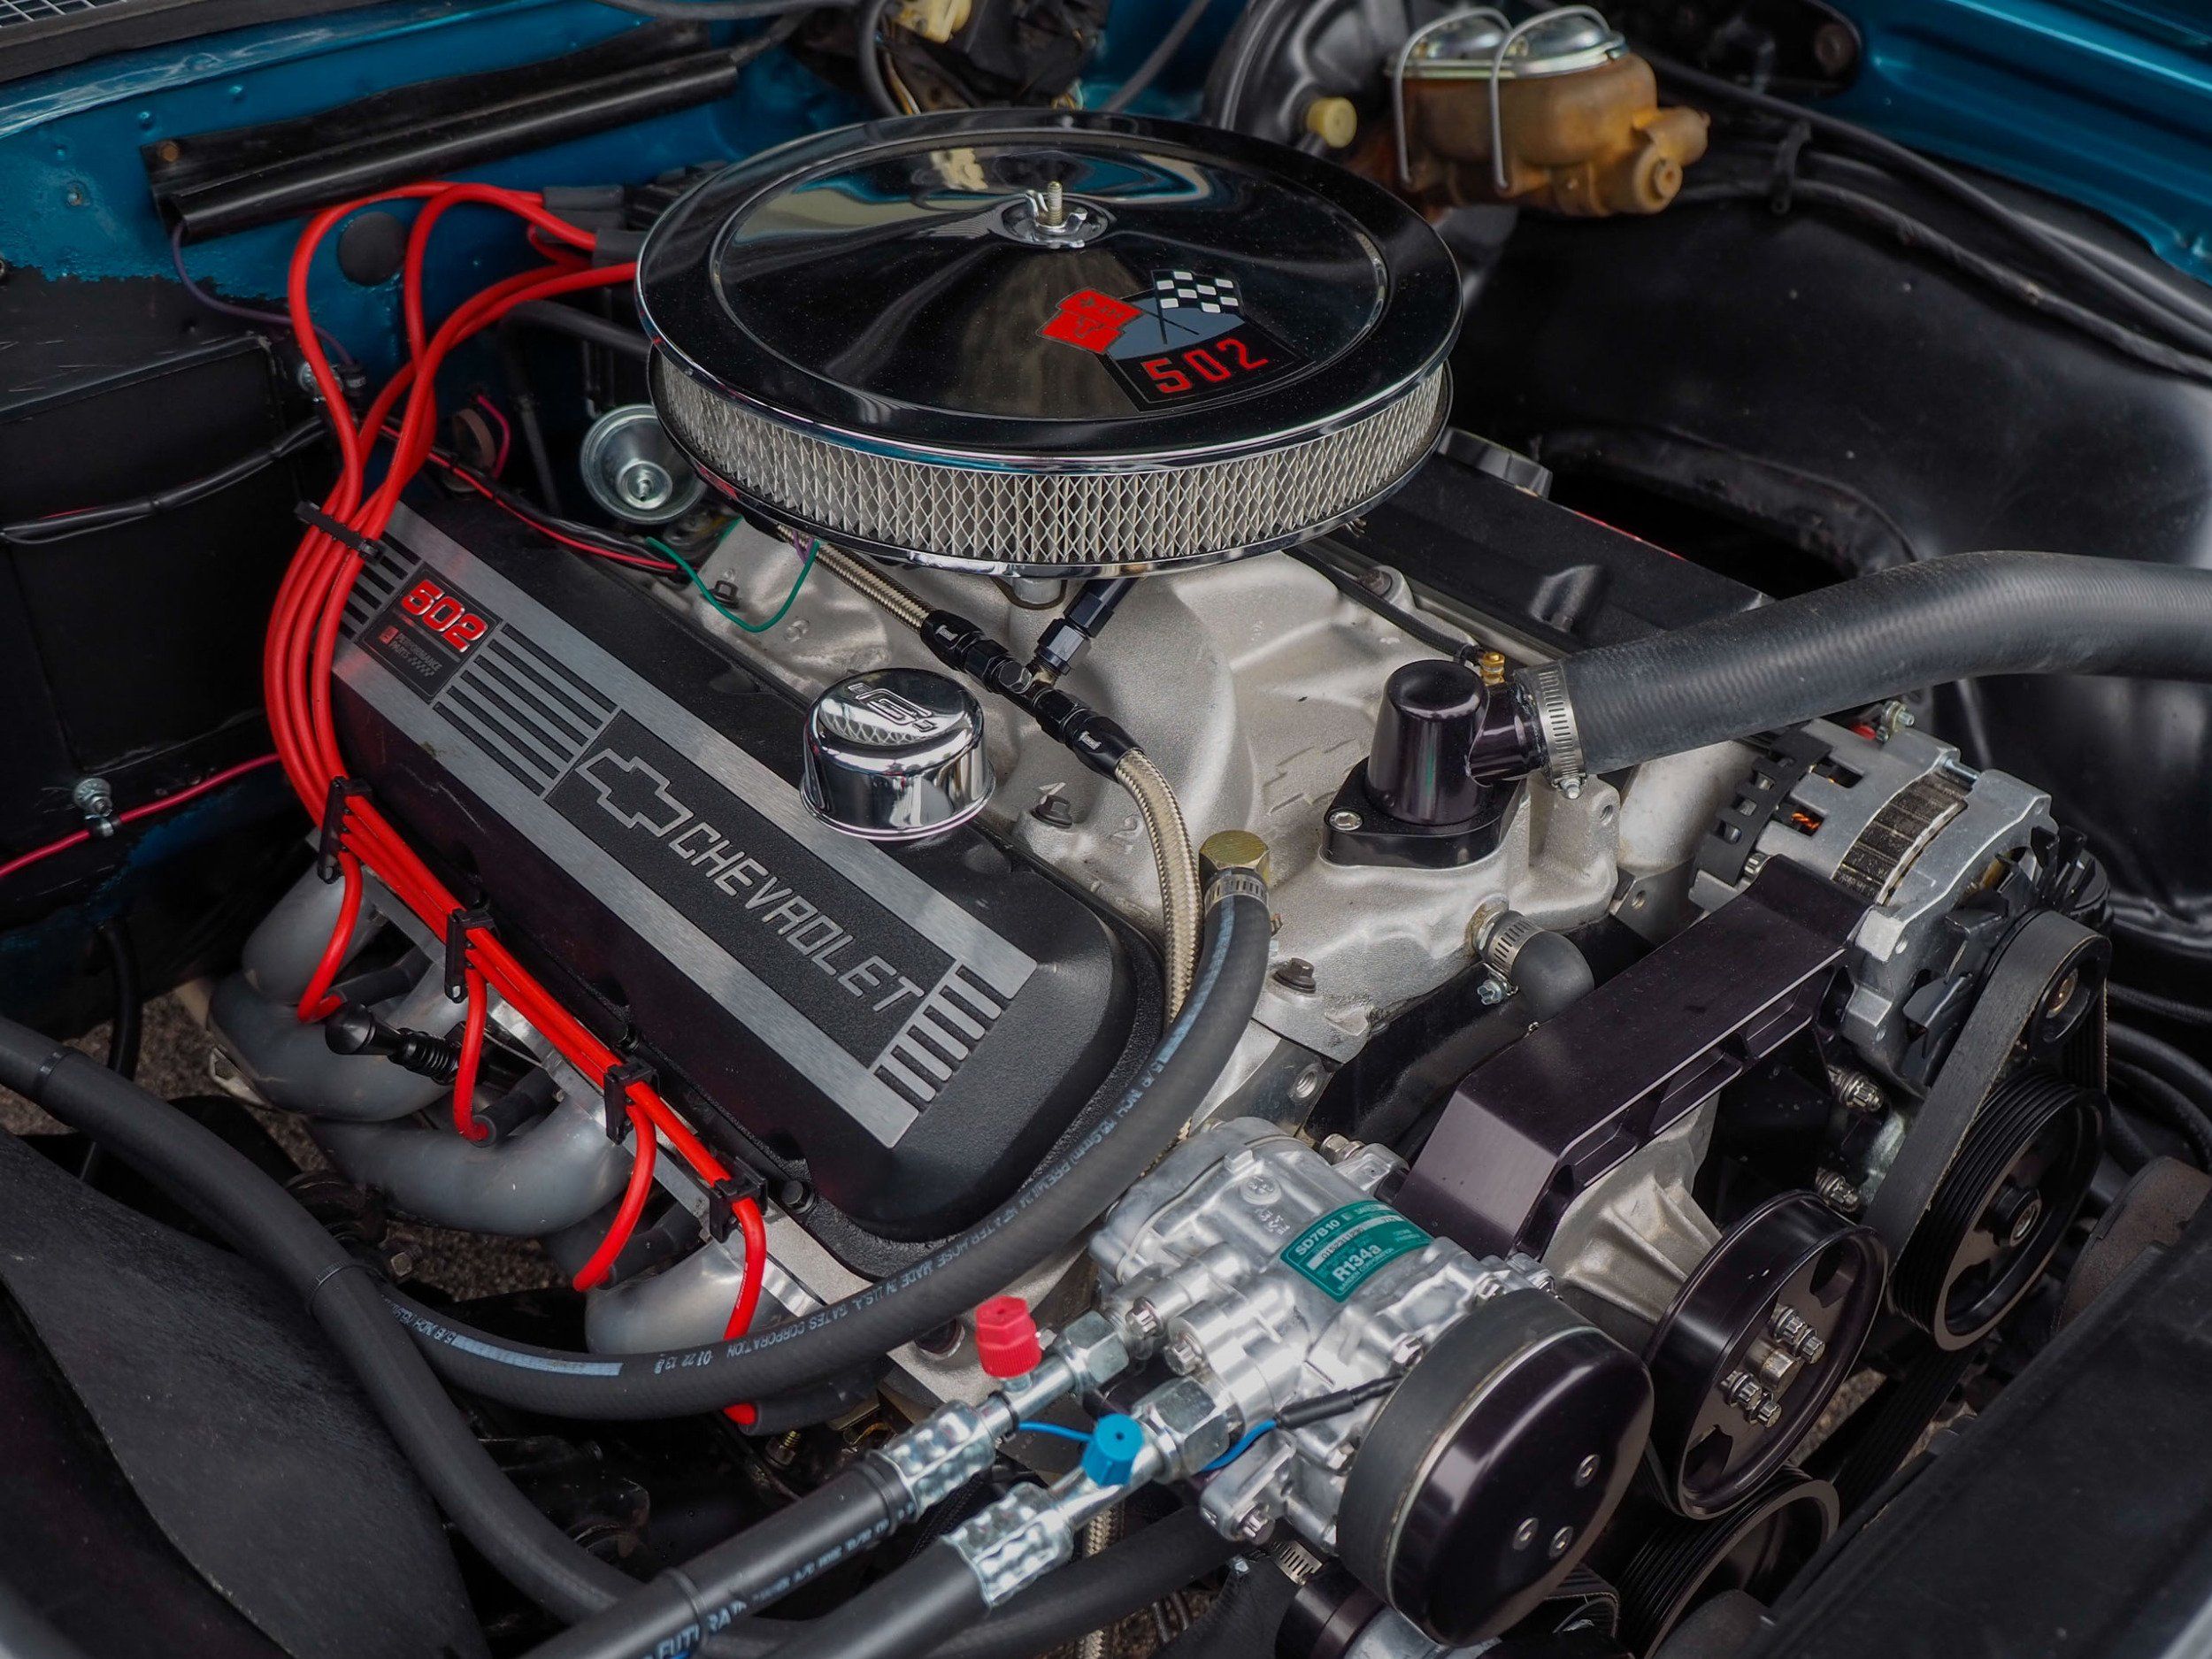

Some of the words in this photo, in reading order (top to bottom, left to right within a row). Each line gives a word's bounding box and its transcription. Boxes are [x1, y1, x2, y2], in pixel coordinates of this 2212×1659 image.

[1140, 338, 1270, 394] 502
[401, 580, 488, 653] 502
[669, 822, 926, 1012] CHEVROLET
[1142, 1061, 1164, 1087] 5/8
[1115, 1088, 1143, 1118] INCH
[1019, 1162, 1071, 1208] PREMIUM
[936, 1238, 969, 1268] HOSE
[1332, 1244, 1383, 1282] R134a
[901, 1260, 933, 1287] MADE
[809, 1302, 849, 1330] GATES
[726, 1321, 805, 1358] CORPORATION
